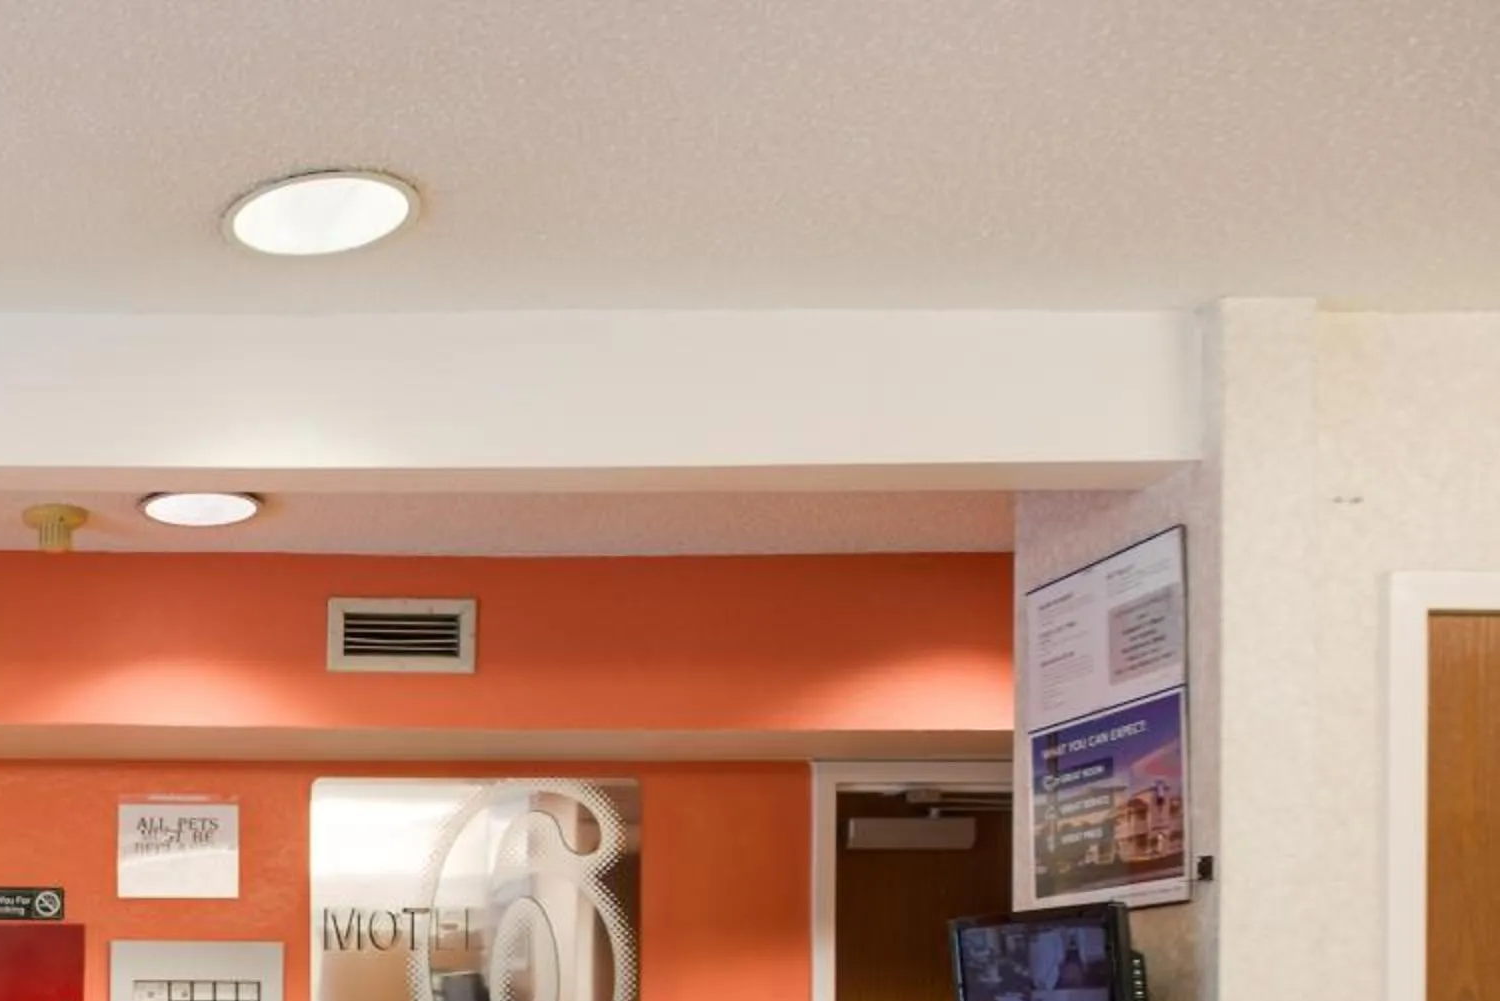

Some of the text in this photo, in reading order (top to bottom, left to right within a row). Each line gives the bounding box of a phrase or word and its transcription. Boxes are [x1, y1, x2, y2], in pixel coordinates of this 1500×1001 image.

[1070, 739, 1087, 753] YOU
[1089, 730, 1111, 748] CAN
[137, 816, 220, 832] ALL PETS
[321, 907, 486, 952] MOTEL
